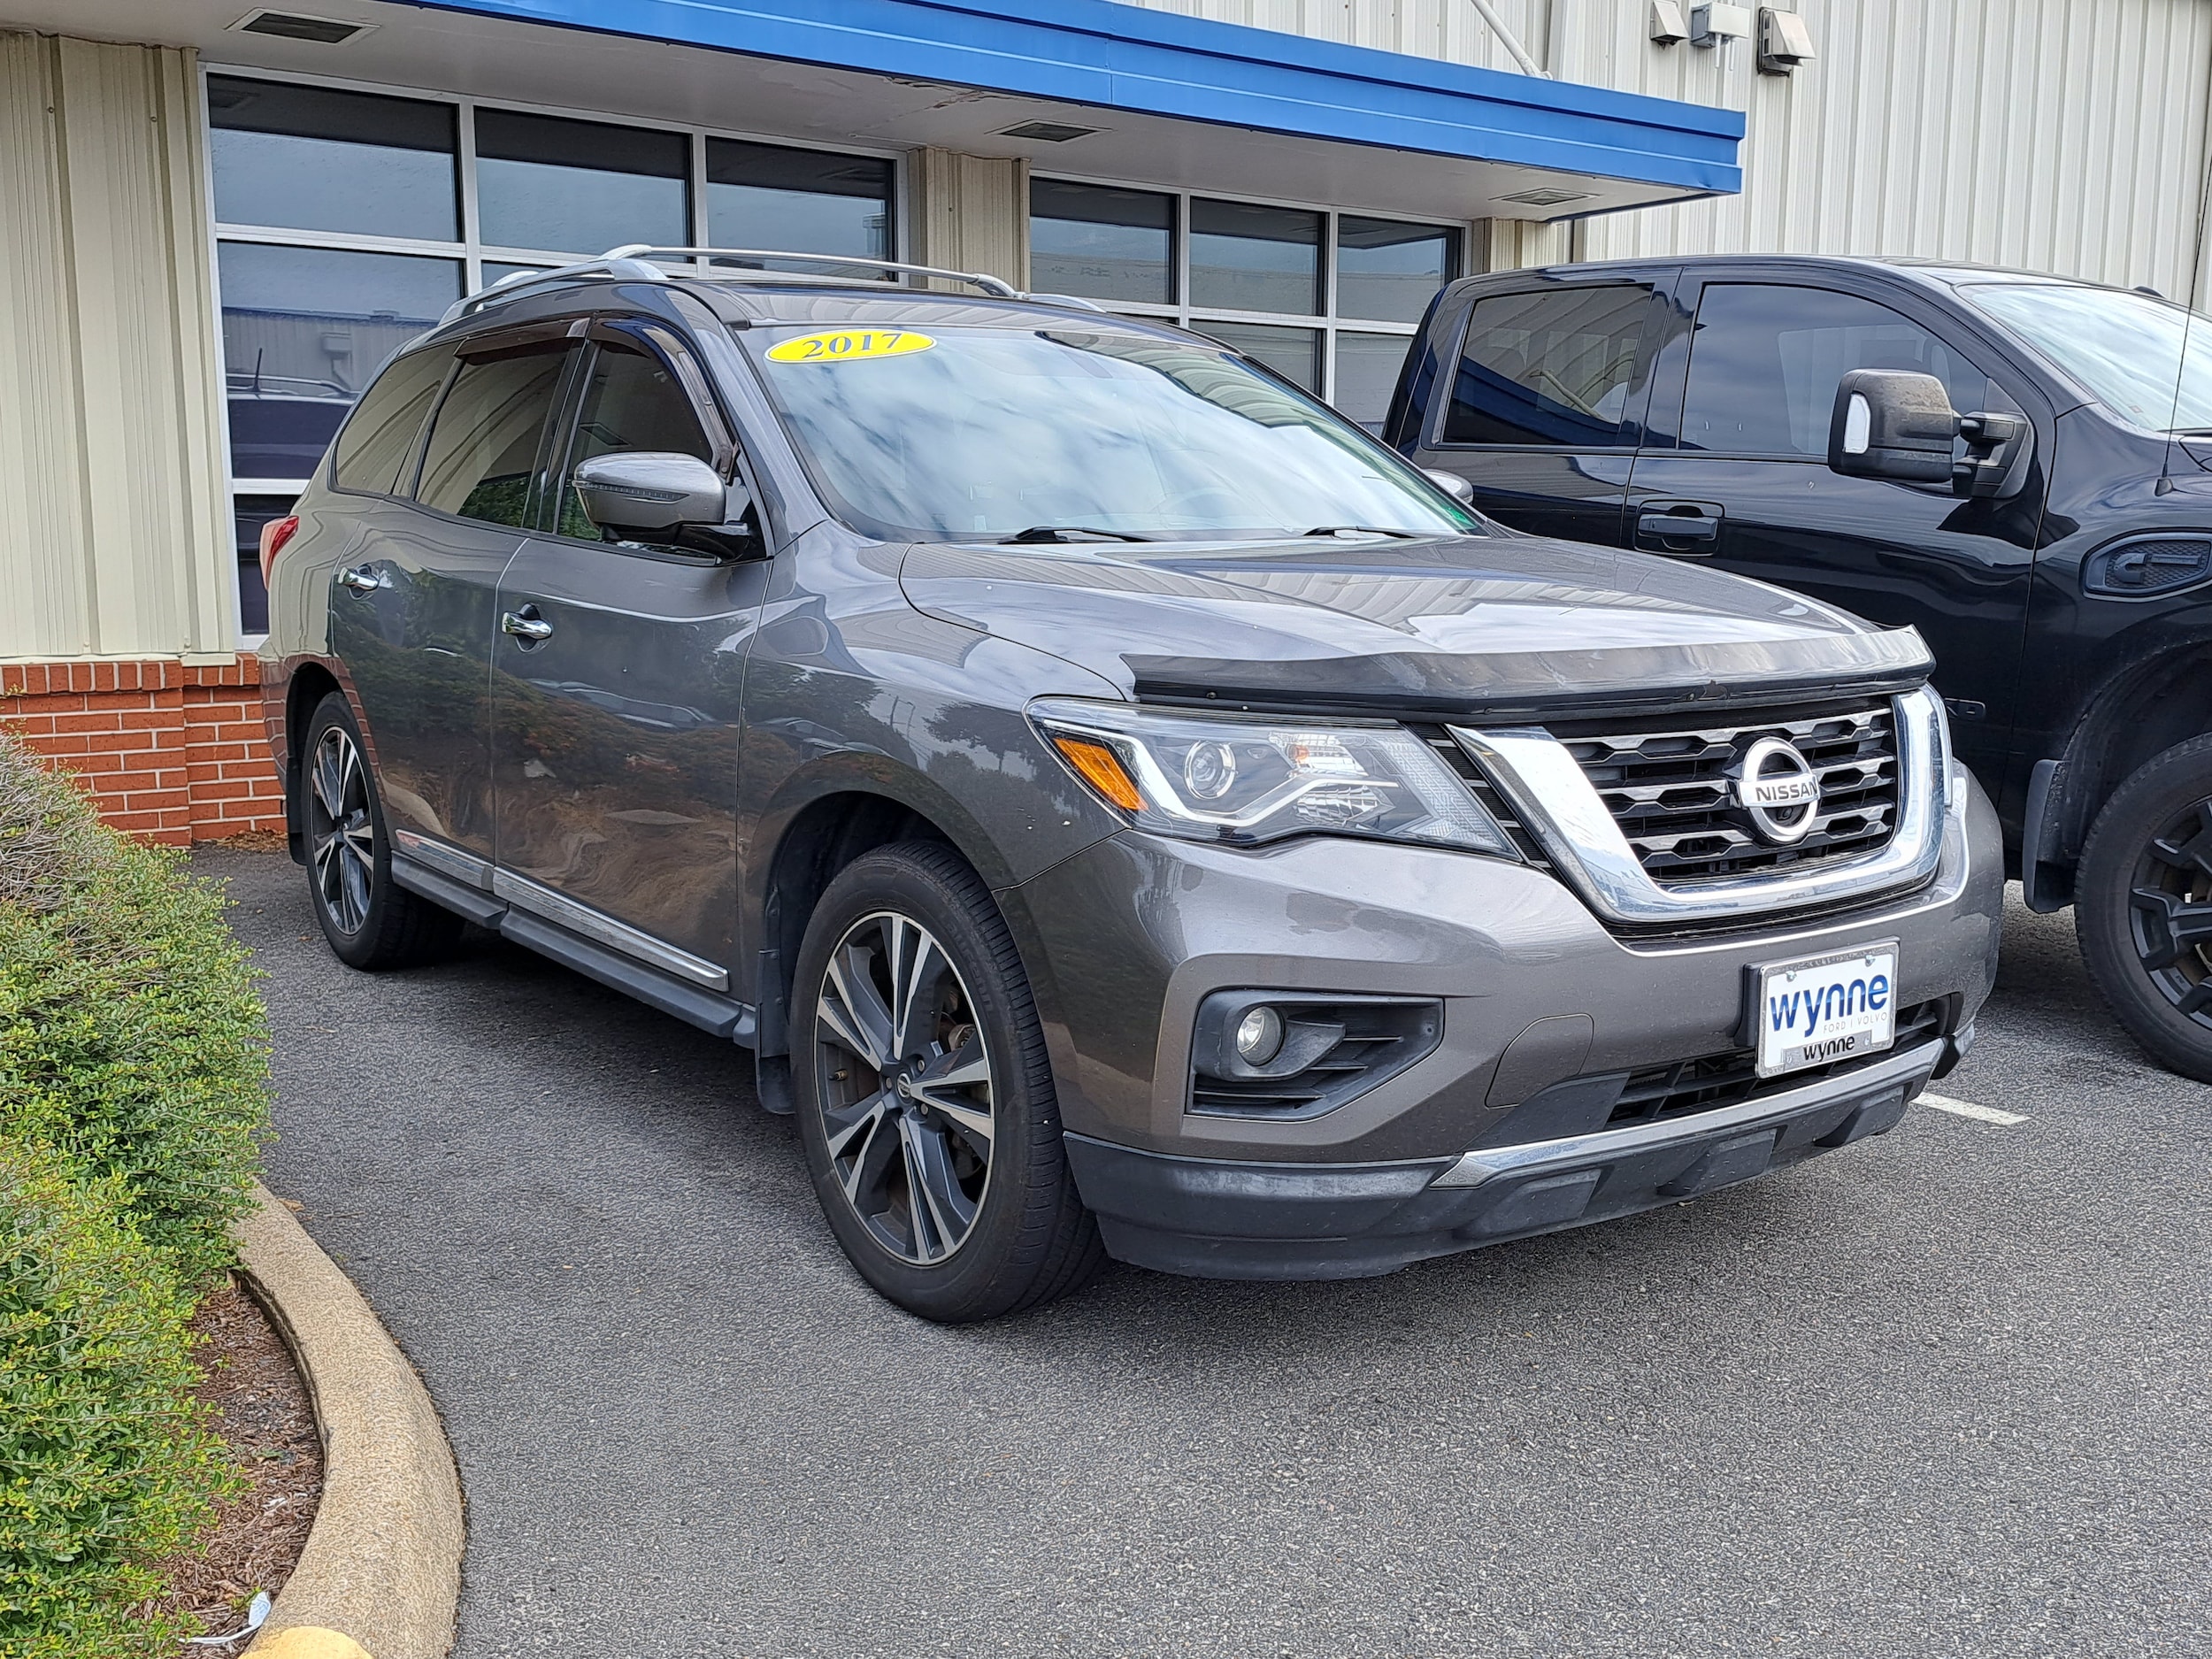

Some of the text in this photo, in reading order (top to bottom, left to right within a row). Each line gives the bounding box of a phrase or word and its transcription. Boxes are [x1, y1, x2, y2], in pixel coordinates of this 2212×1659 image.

[803, 333, 902, 358] 2017
[1755, 781, 1817, 802] NISSAN
[1770, 974, 1888, 1038] wynne
[1824, 1021, 1846, 1033] FORD
[1857, 1012, 1887, 1025] VOLVO
[1803, 1036, 1855, 1062] wynne
